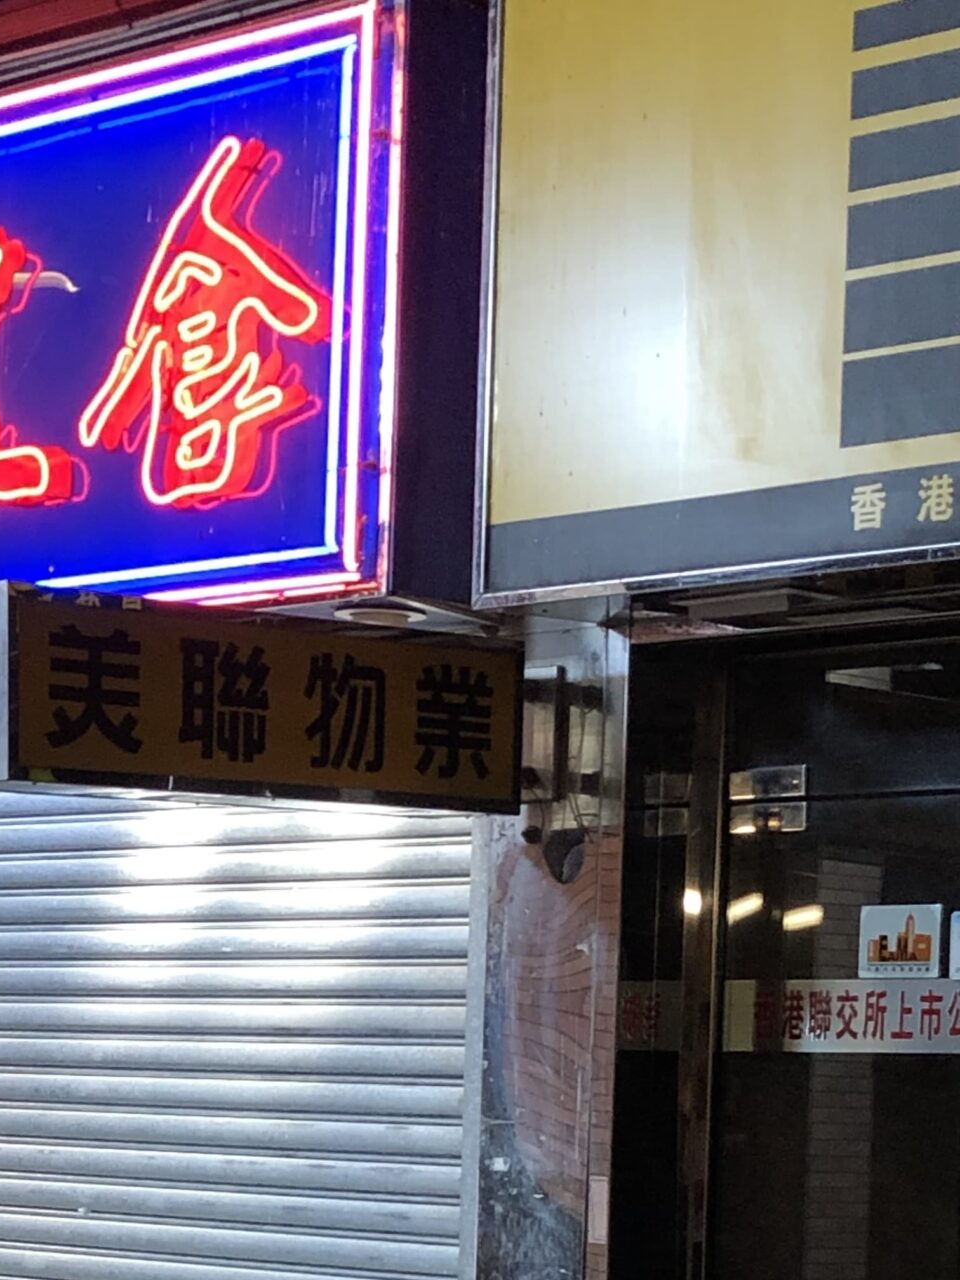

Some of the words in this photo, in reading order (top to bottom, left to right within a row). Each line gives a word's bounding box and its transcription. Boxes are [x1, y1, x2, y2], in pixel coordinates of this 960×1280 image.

[850, 474, 954, 531] 香港
[45, 624, 494, 781] 美聯物業
